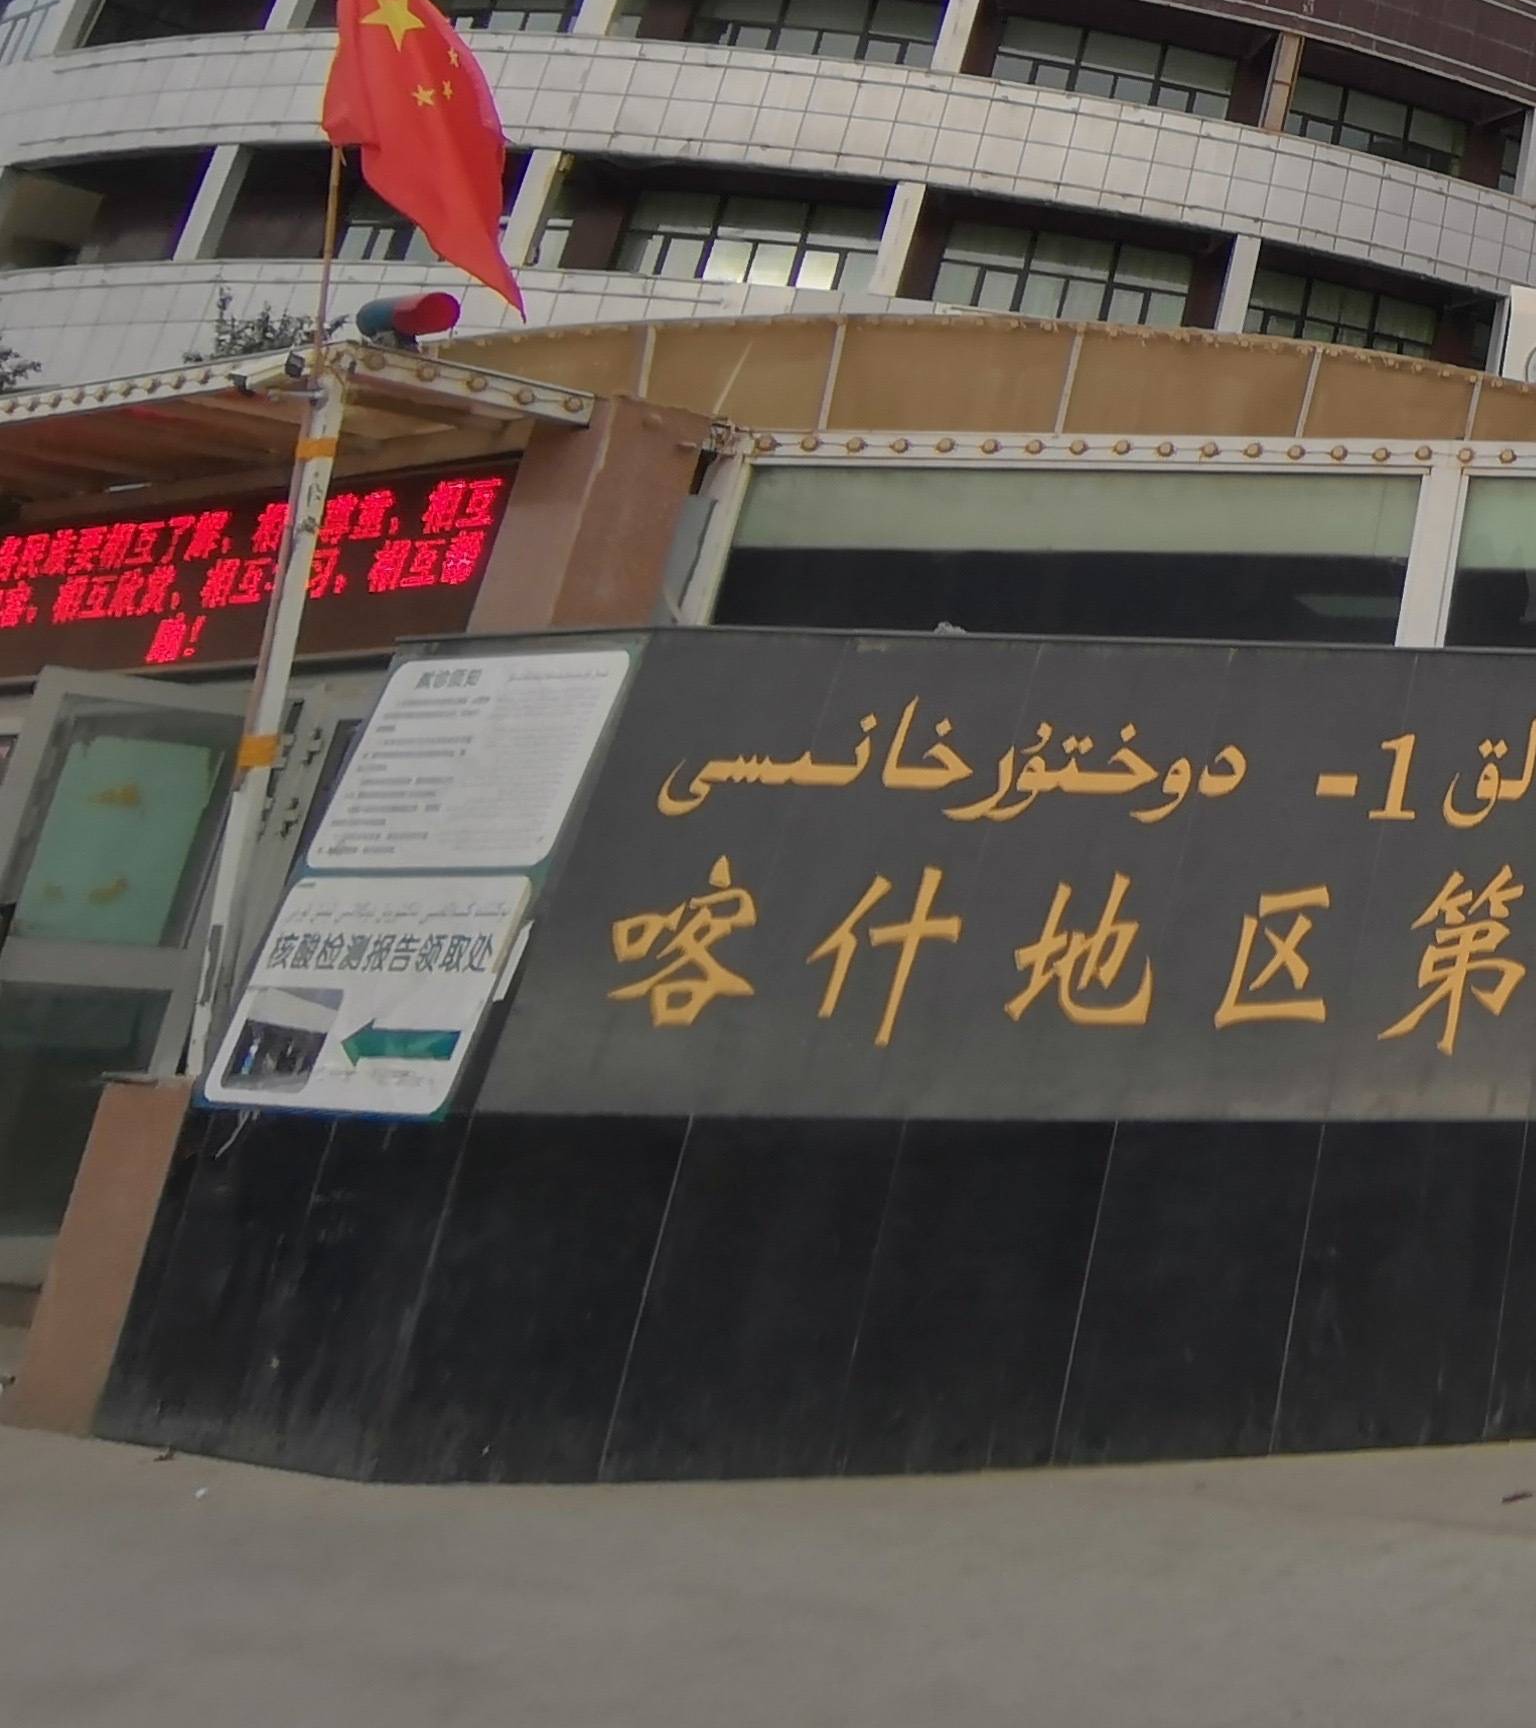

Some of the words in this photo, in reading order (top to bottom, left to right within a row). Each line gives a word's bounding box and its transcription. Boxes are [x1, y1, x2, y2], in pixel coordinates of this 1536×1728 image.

[656, 695, 1248, 824] دوختۇرخانىسى
[267, 932, 494, 973] 核酸检测报告领取处
